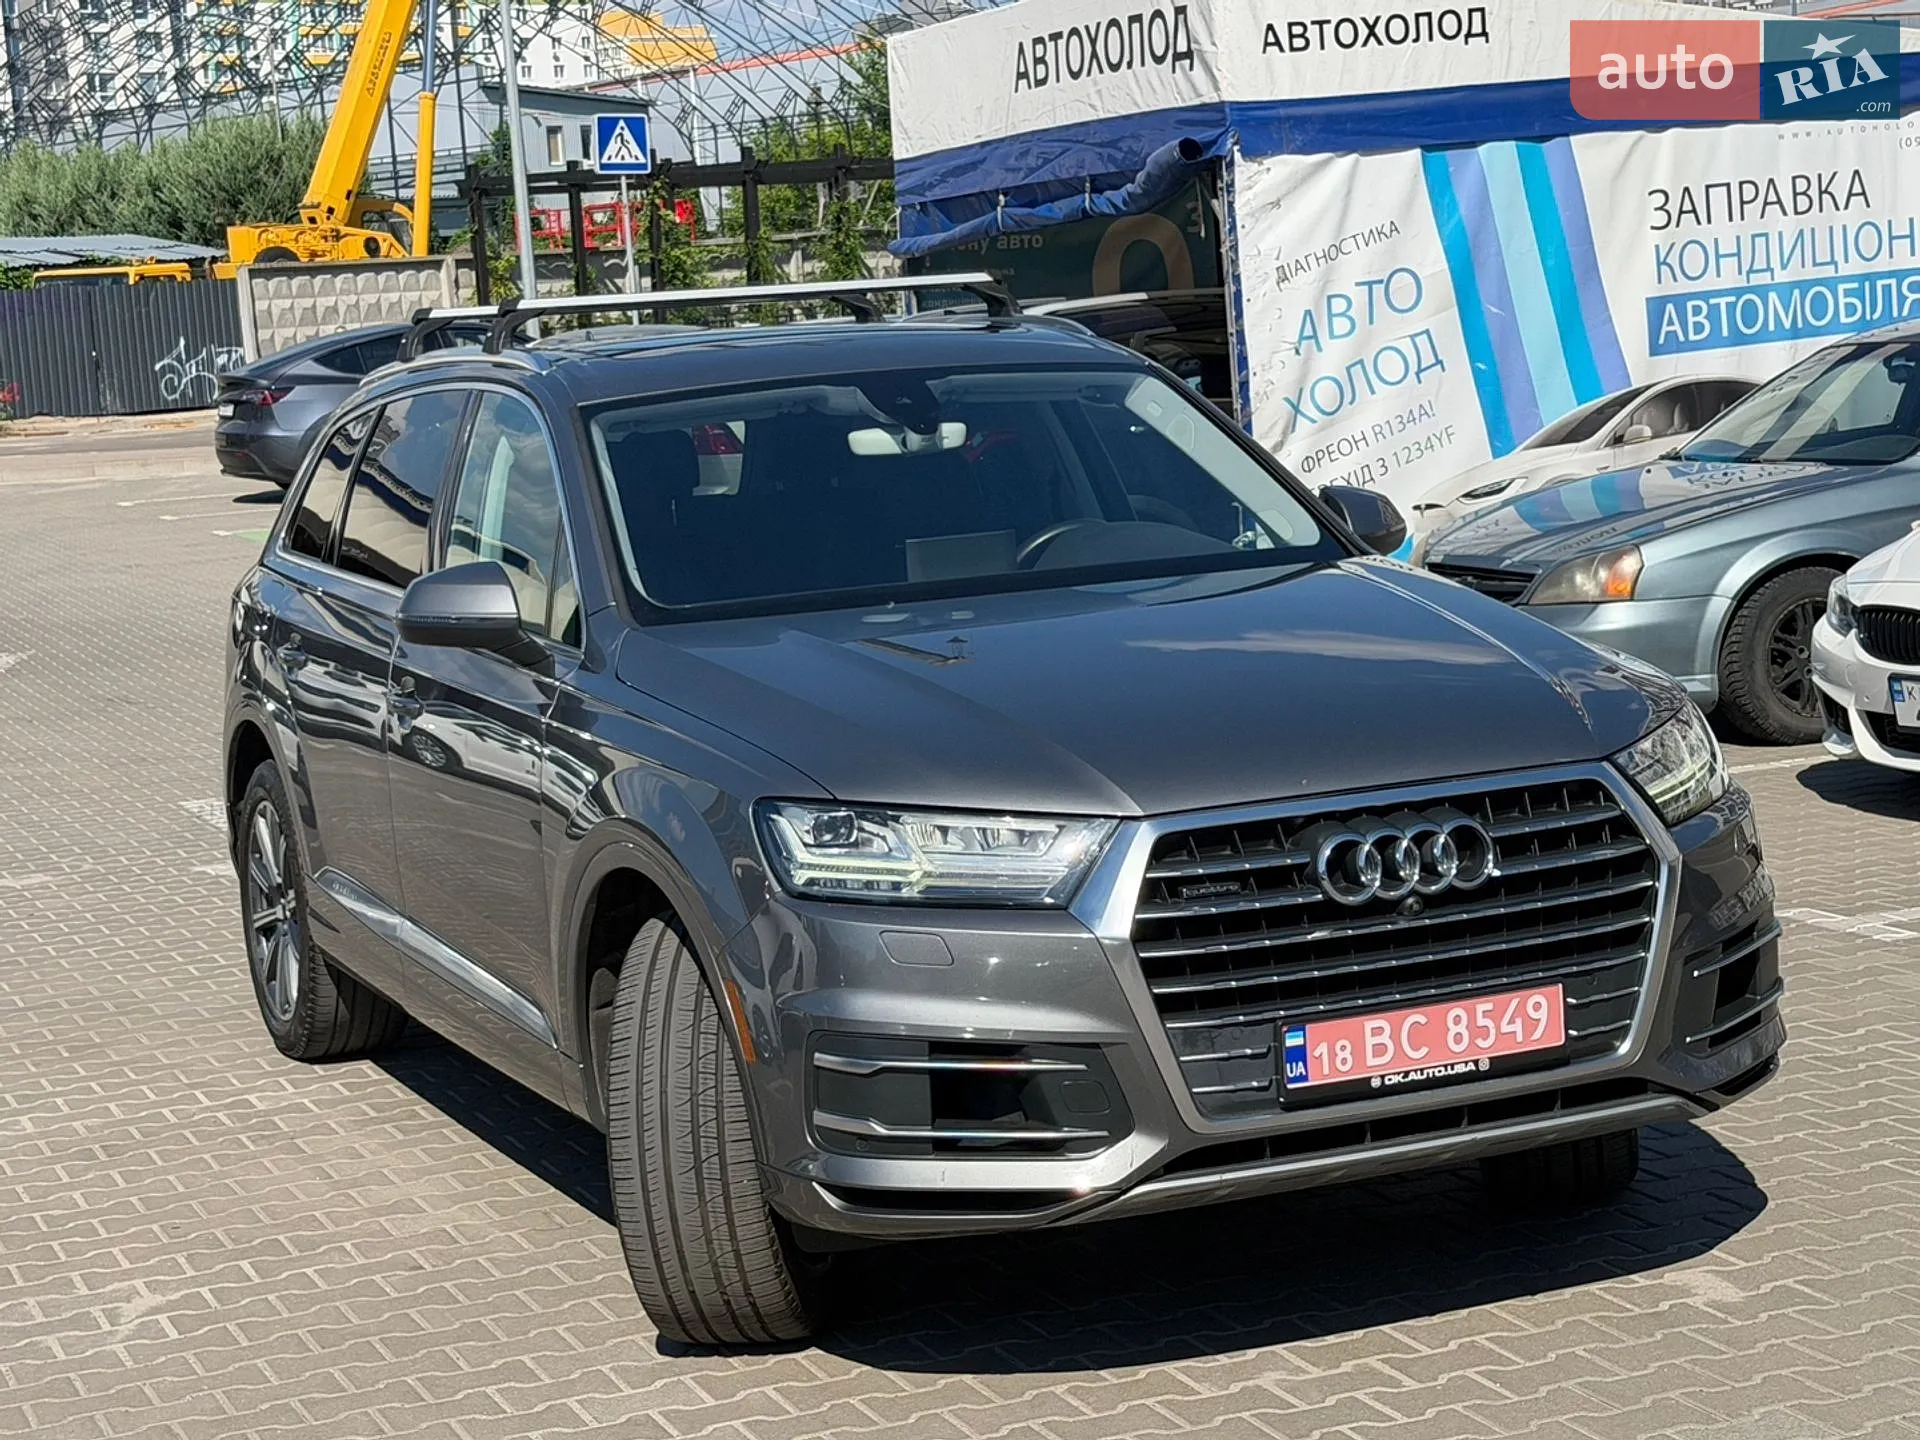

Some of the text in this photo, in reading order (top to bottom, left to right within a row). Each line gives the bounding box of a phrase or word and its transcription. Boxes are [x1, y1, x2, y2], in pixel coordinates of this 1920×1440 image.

[1014, 4, 1195, 94] АВТОХОЛОД
[1262, 7, 1489, 55] АВТОХОЛОД
[1648, 169, 1871, 231] ЗАПРАВКА
[1275, 220, 1401, 292] ДІАГНОСТИКА
[1295, 267, 1424, 356] АВТО
[1658, 276, 1920, 345] АВТОМОБІЛЯ
[1282, 328, 1446, 434] ХОЛОД
[1301, 399, 1436, 474] ФРЕОН R134A!
[1392, 424, 1457, 469] 1234YF
[1286, 1062, 1306, 1078] UA
[1313, 994, 1549, 1076] 18 BC 8549
[1384, 1062, 1477, 1086] OK.AUTO.USA
